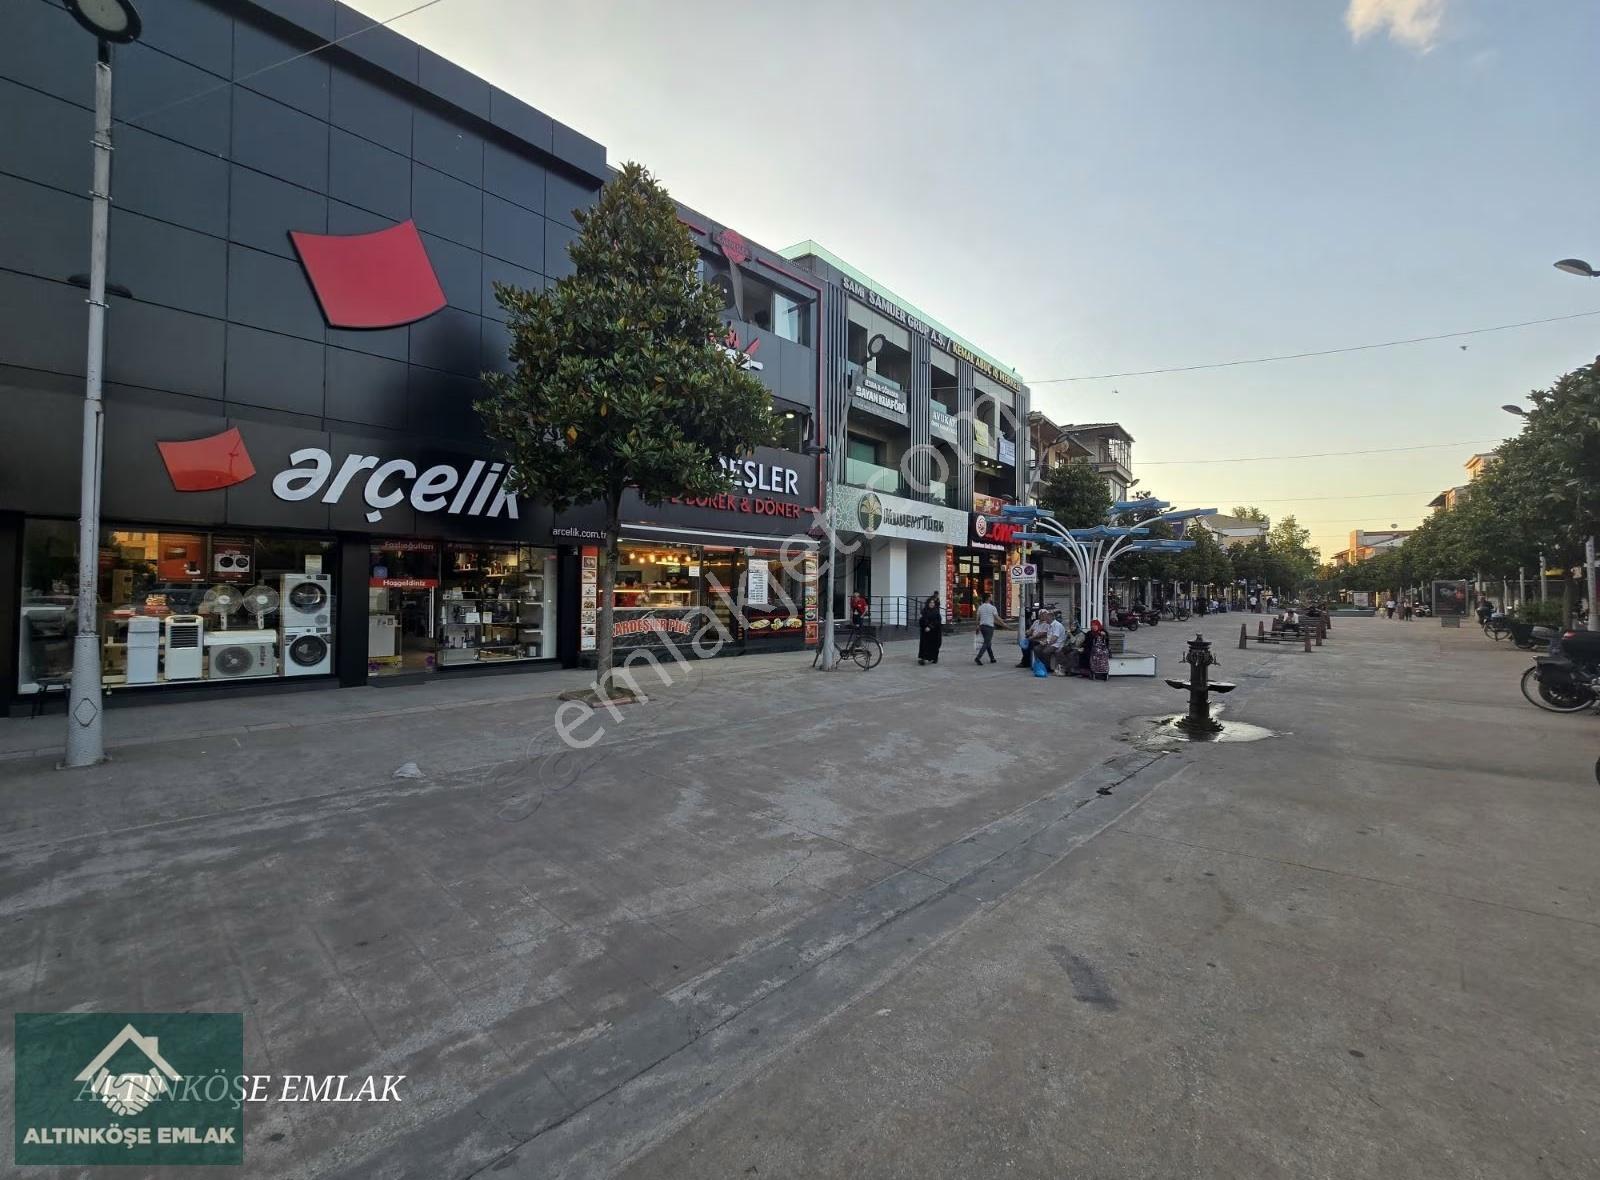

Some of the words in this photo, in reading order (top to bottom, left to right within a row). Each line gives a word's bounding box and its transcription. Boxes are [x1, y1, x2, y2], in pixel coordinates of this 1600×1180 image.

[907, 315, 930, 335] GRUP
[855, 386, 879, 403] BAYAN
[272, 447, 520, 523] arçelik
[740, 497, 752, 513] &
[755, 497, 800, 518] DÖNER
[552, 527, 607, 539] arcelik.com.tr
[382, 579, 426, 588] Hoşgeldiniz
